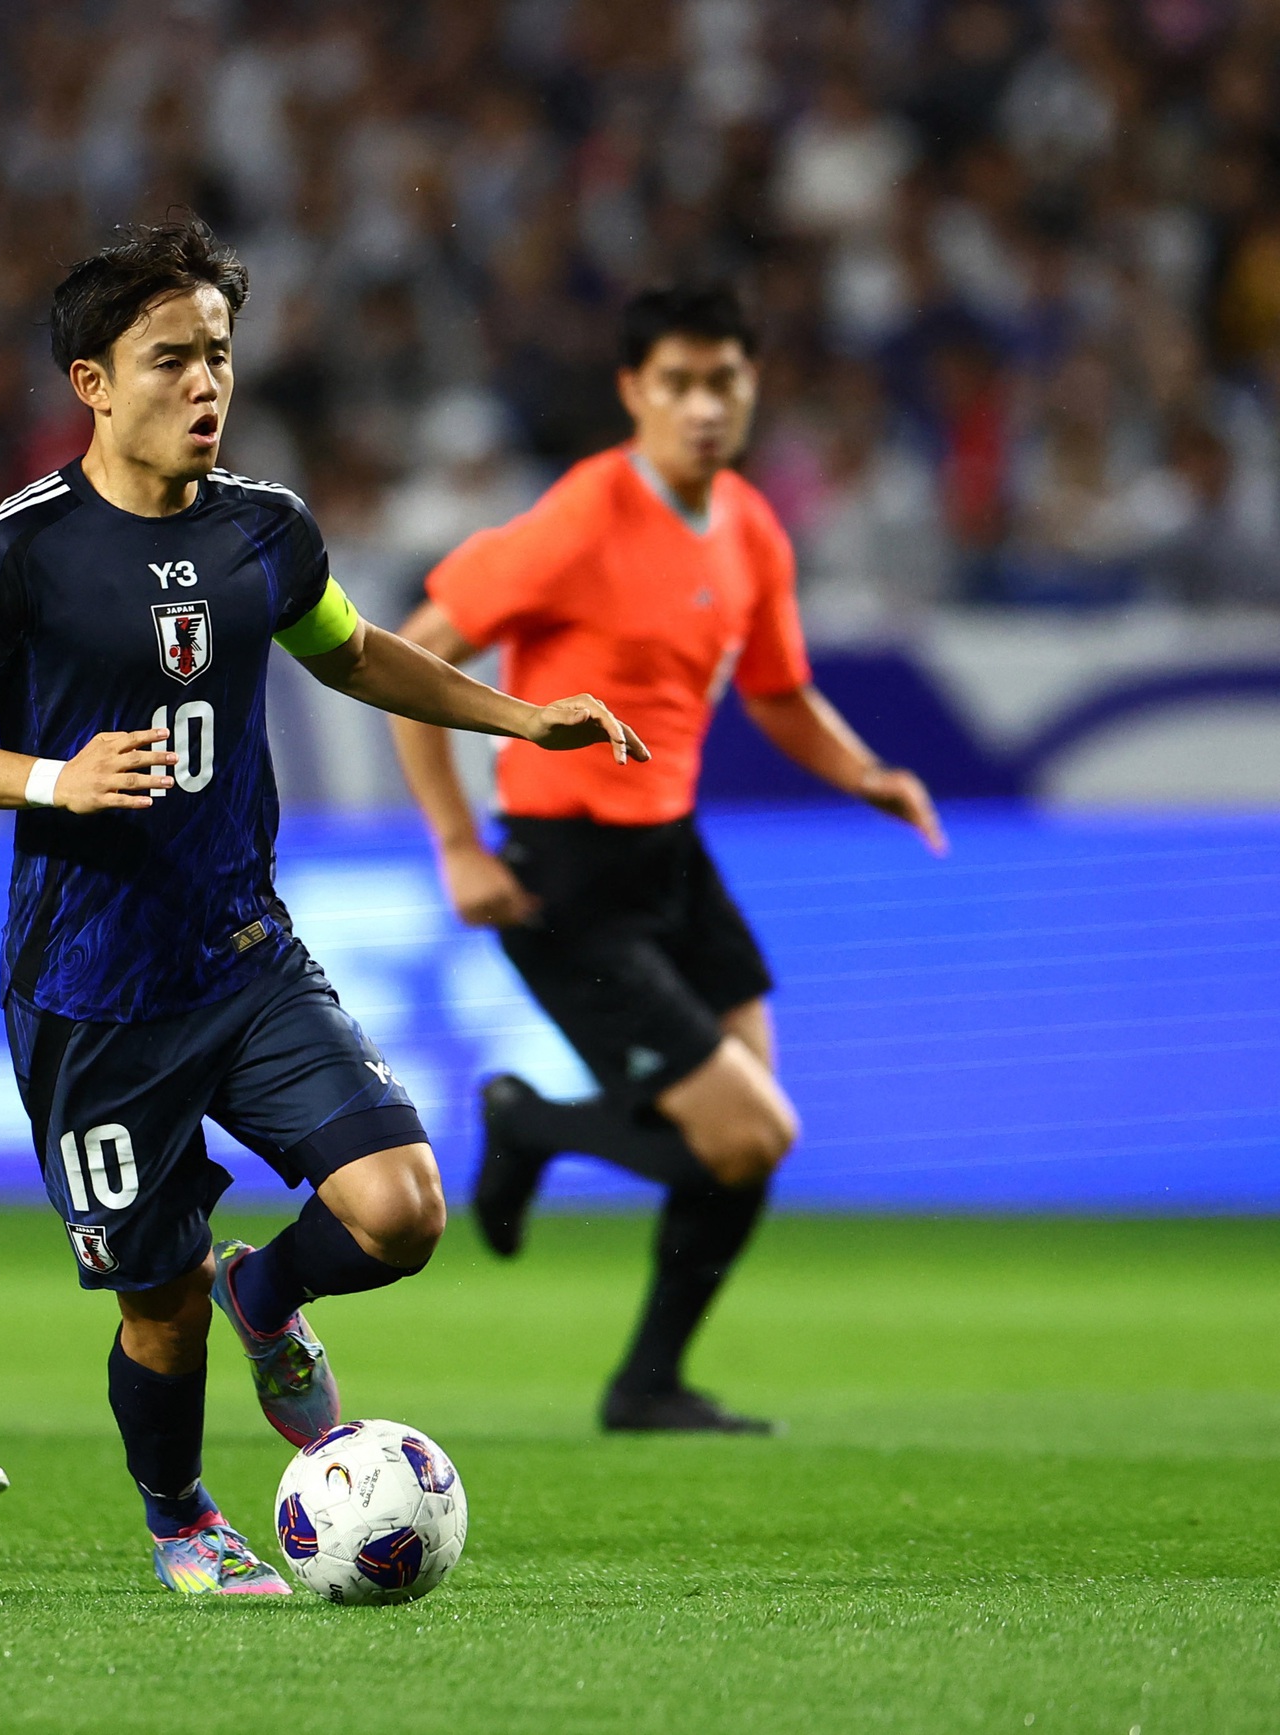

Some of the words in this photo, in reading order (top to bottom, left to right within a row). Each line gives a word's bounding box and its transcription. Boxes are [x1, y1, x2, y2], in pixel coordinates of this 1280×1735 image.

[147, 559, 198, 590] Y-3
[166, 604, 195, 615] JAPAN
[150, 700, 215, 797] 10
[60, 1122, 140, 1212] 10
